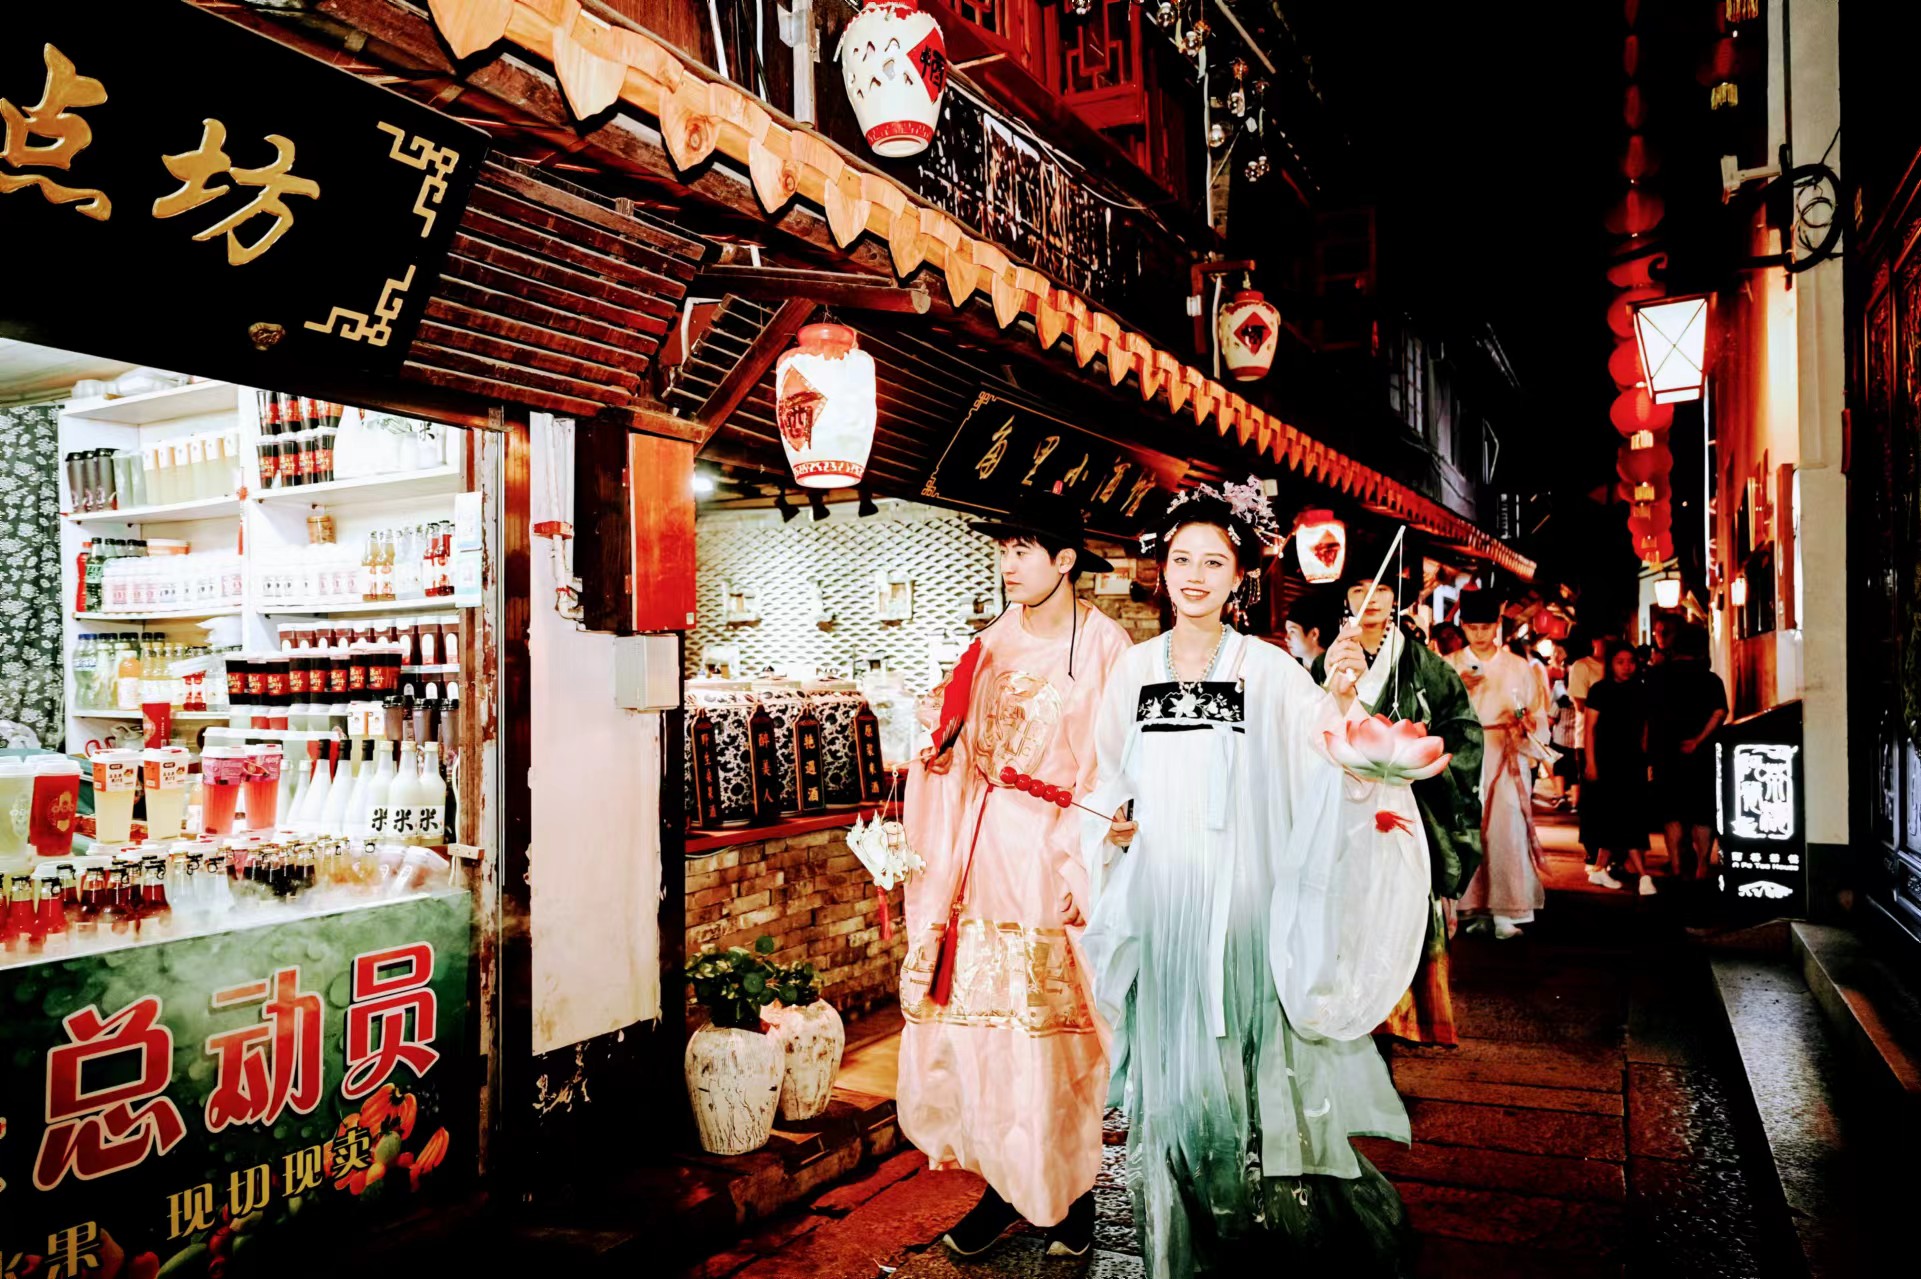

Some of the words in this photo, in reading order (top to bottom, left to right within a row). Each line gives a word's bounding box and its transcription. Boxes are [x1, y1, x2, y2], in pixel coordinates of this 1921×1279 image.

[0, 42, 320, 266] 点坊
[758, 732, 774, 803] 醉美人
[393, 808, 413, 833] 米
[419, 808, 438, 832] 米
[0, 940, 441, 1192] 总动员
[166, 1126, 372, 1241] 现切现卖
